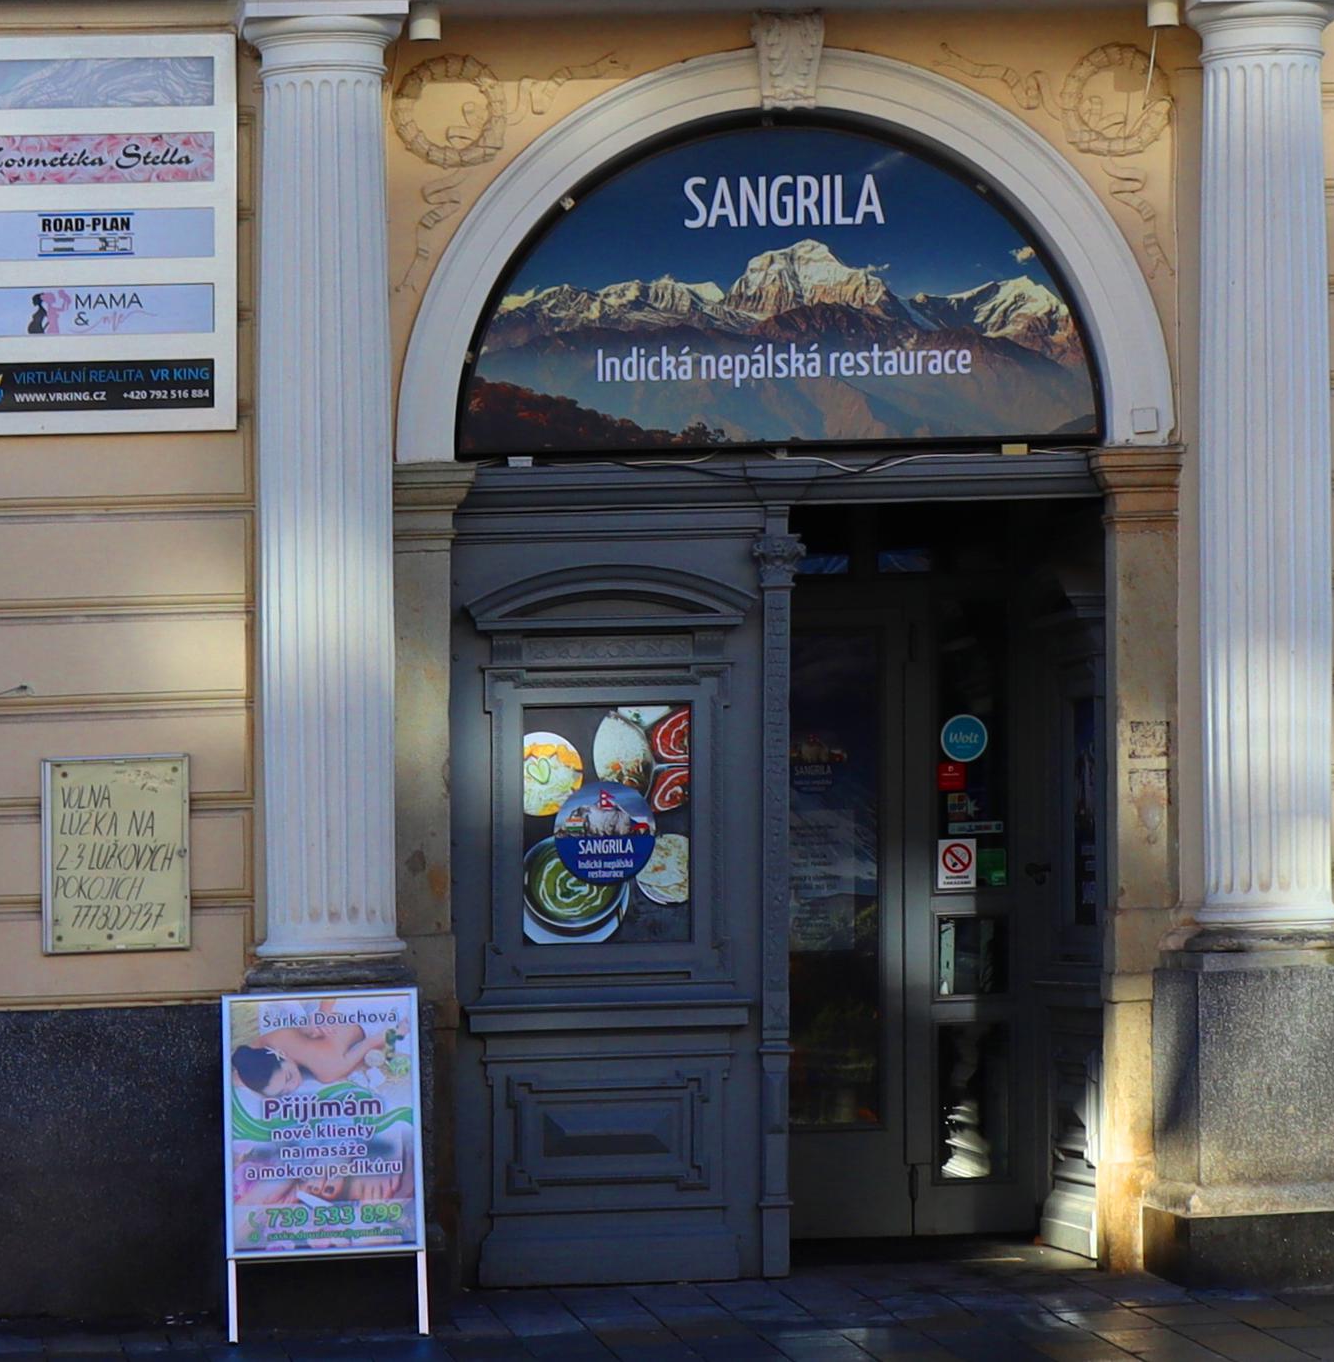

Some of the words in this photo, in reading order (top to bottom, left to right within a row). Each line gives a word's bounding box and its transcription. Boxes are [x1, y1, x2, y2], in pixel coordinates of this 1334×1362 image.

[115, 144, 194, 169] Stella
[684, 173, 885, 229] SANGRILA
[42, 217, 131, 232] ROAD-PLAN
[75, 292, 143, 310] MAMA
[74, 311, 89, 326] &
[597, 348, 692, 383] Indická
[700, 342, 821, 387] nepálská
[829, 343, 972, 377] restaurace
[13, 368, 87, 385] VIRTUÁLNÍ
[89, 370, 144, 383] REALITA
[150, 369, 170, 381] VR
[174, 367, 210, 380] KING
[14, 392, 107, 403] WWW.VRKING.CZ
[123, 390, 147, 400] +420
[149, 390, 168, 399] 792
[170, 389, 189, 399] 516
[191, 389, 210, 398] 884
[578, 838, 634, 855] SANGRILA
[314, 1009, 397, 1026] Douchová
[264, 1094, 382, 1122] Přijímám
[272, 1125, 311, 1140] nové
[316, 1123, 375, 1139] klienty
[281, 1146, 304, 1159] na
[306, 1142, 367, 1158] masáže
[247, 1168, 259, 1179] a
[261, 1163, 323, 1179] mokrou
[329, 1160, 403, 1180] pedikúru
[267, 1208, 308, 1228] 739
[313, 1205, 356, 1226] 533
[361, 1203, 403, 1223] 899
